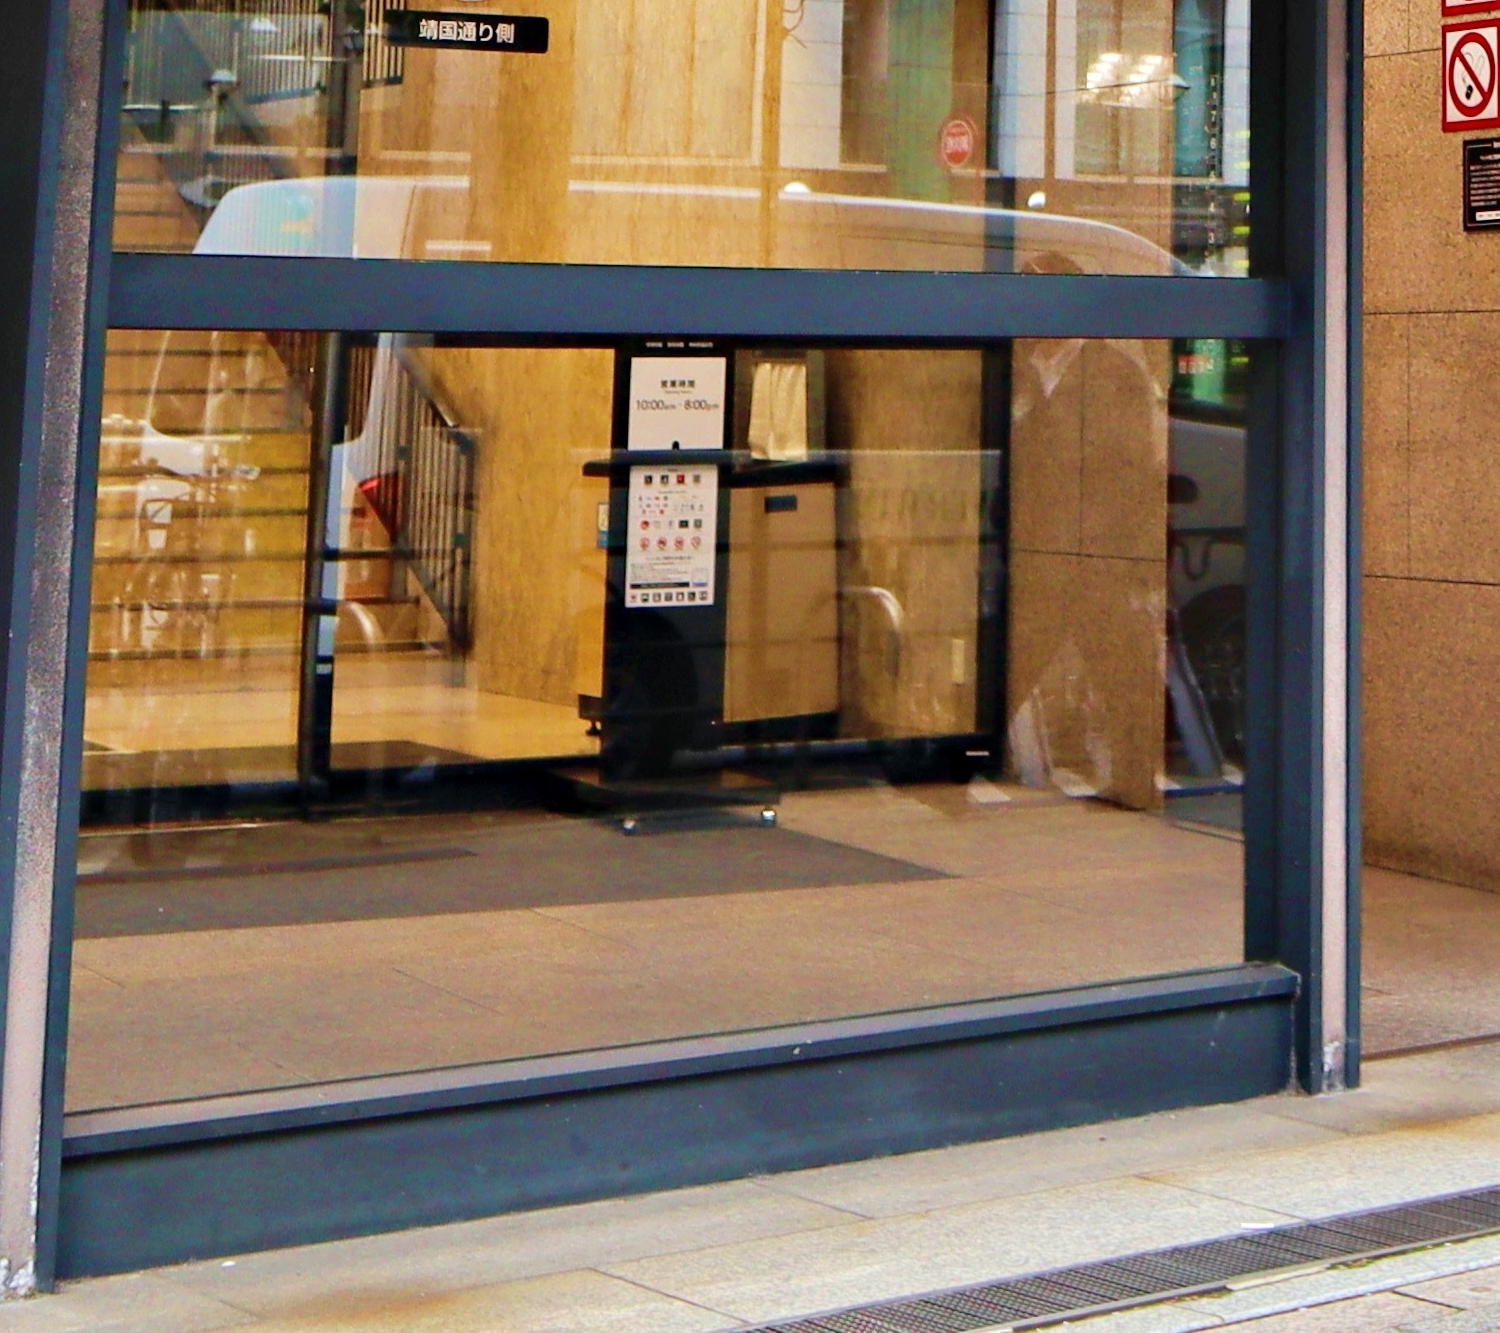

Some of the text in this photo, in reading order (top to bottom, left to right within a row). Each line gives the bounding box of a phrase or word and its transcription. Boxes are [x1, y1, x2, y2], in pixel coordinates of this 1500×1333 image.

[419, 19, 515, 43] 靖国通り側
